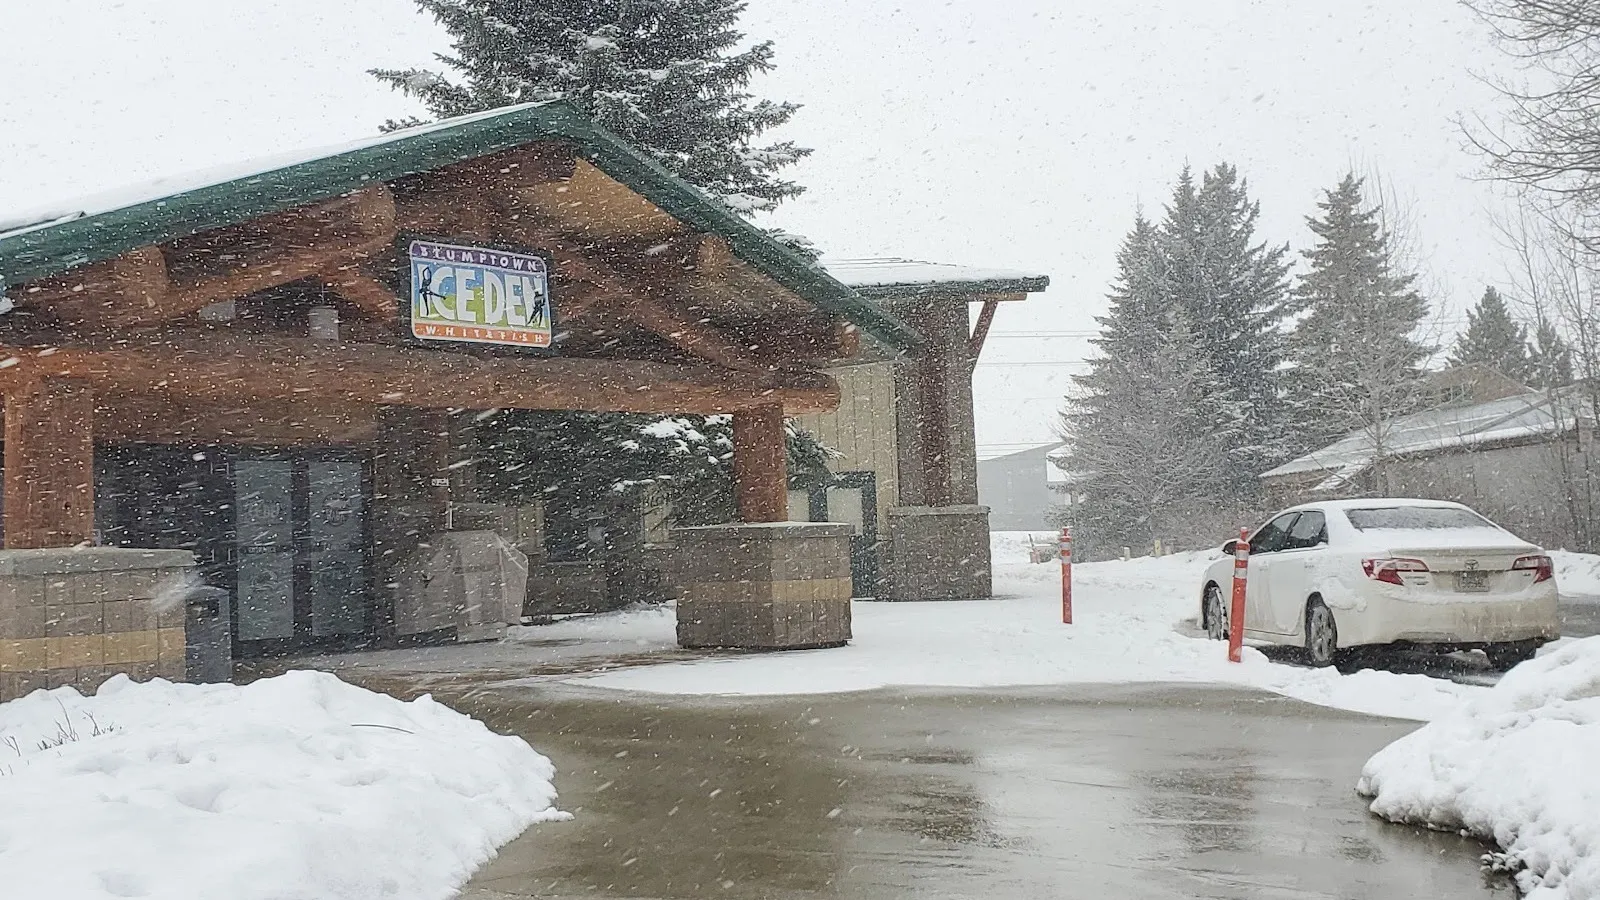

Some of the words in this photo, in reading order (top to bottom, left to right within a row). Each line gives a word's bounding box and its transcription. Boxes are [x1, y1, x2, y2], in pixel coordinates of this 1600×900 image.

[420, 246, 537, 271] STUMPTOWN
[417, 264, 477, 322] ICE
[484, 269, 547, 328] DEN
[425, 325, 544, 343] WHITEFISH
